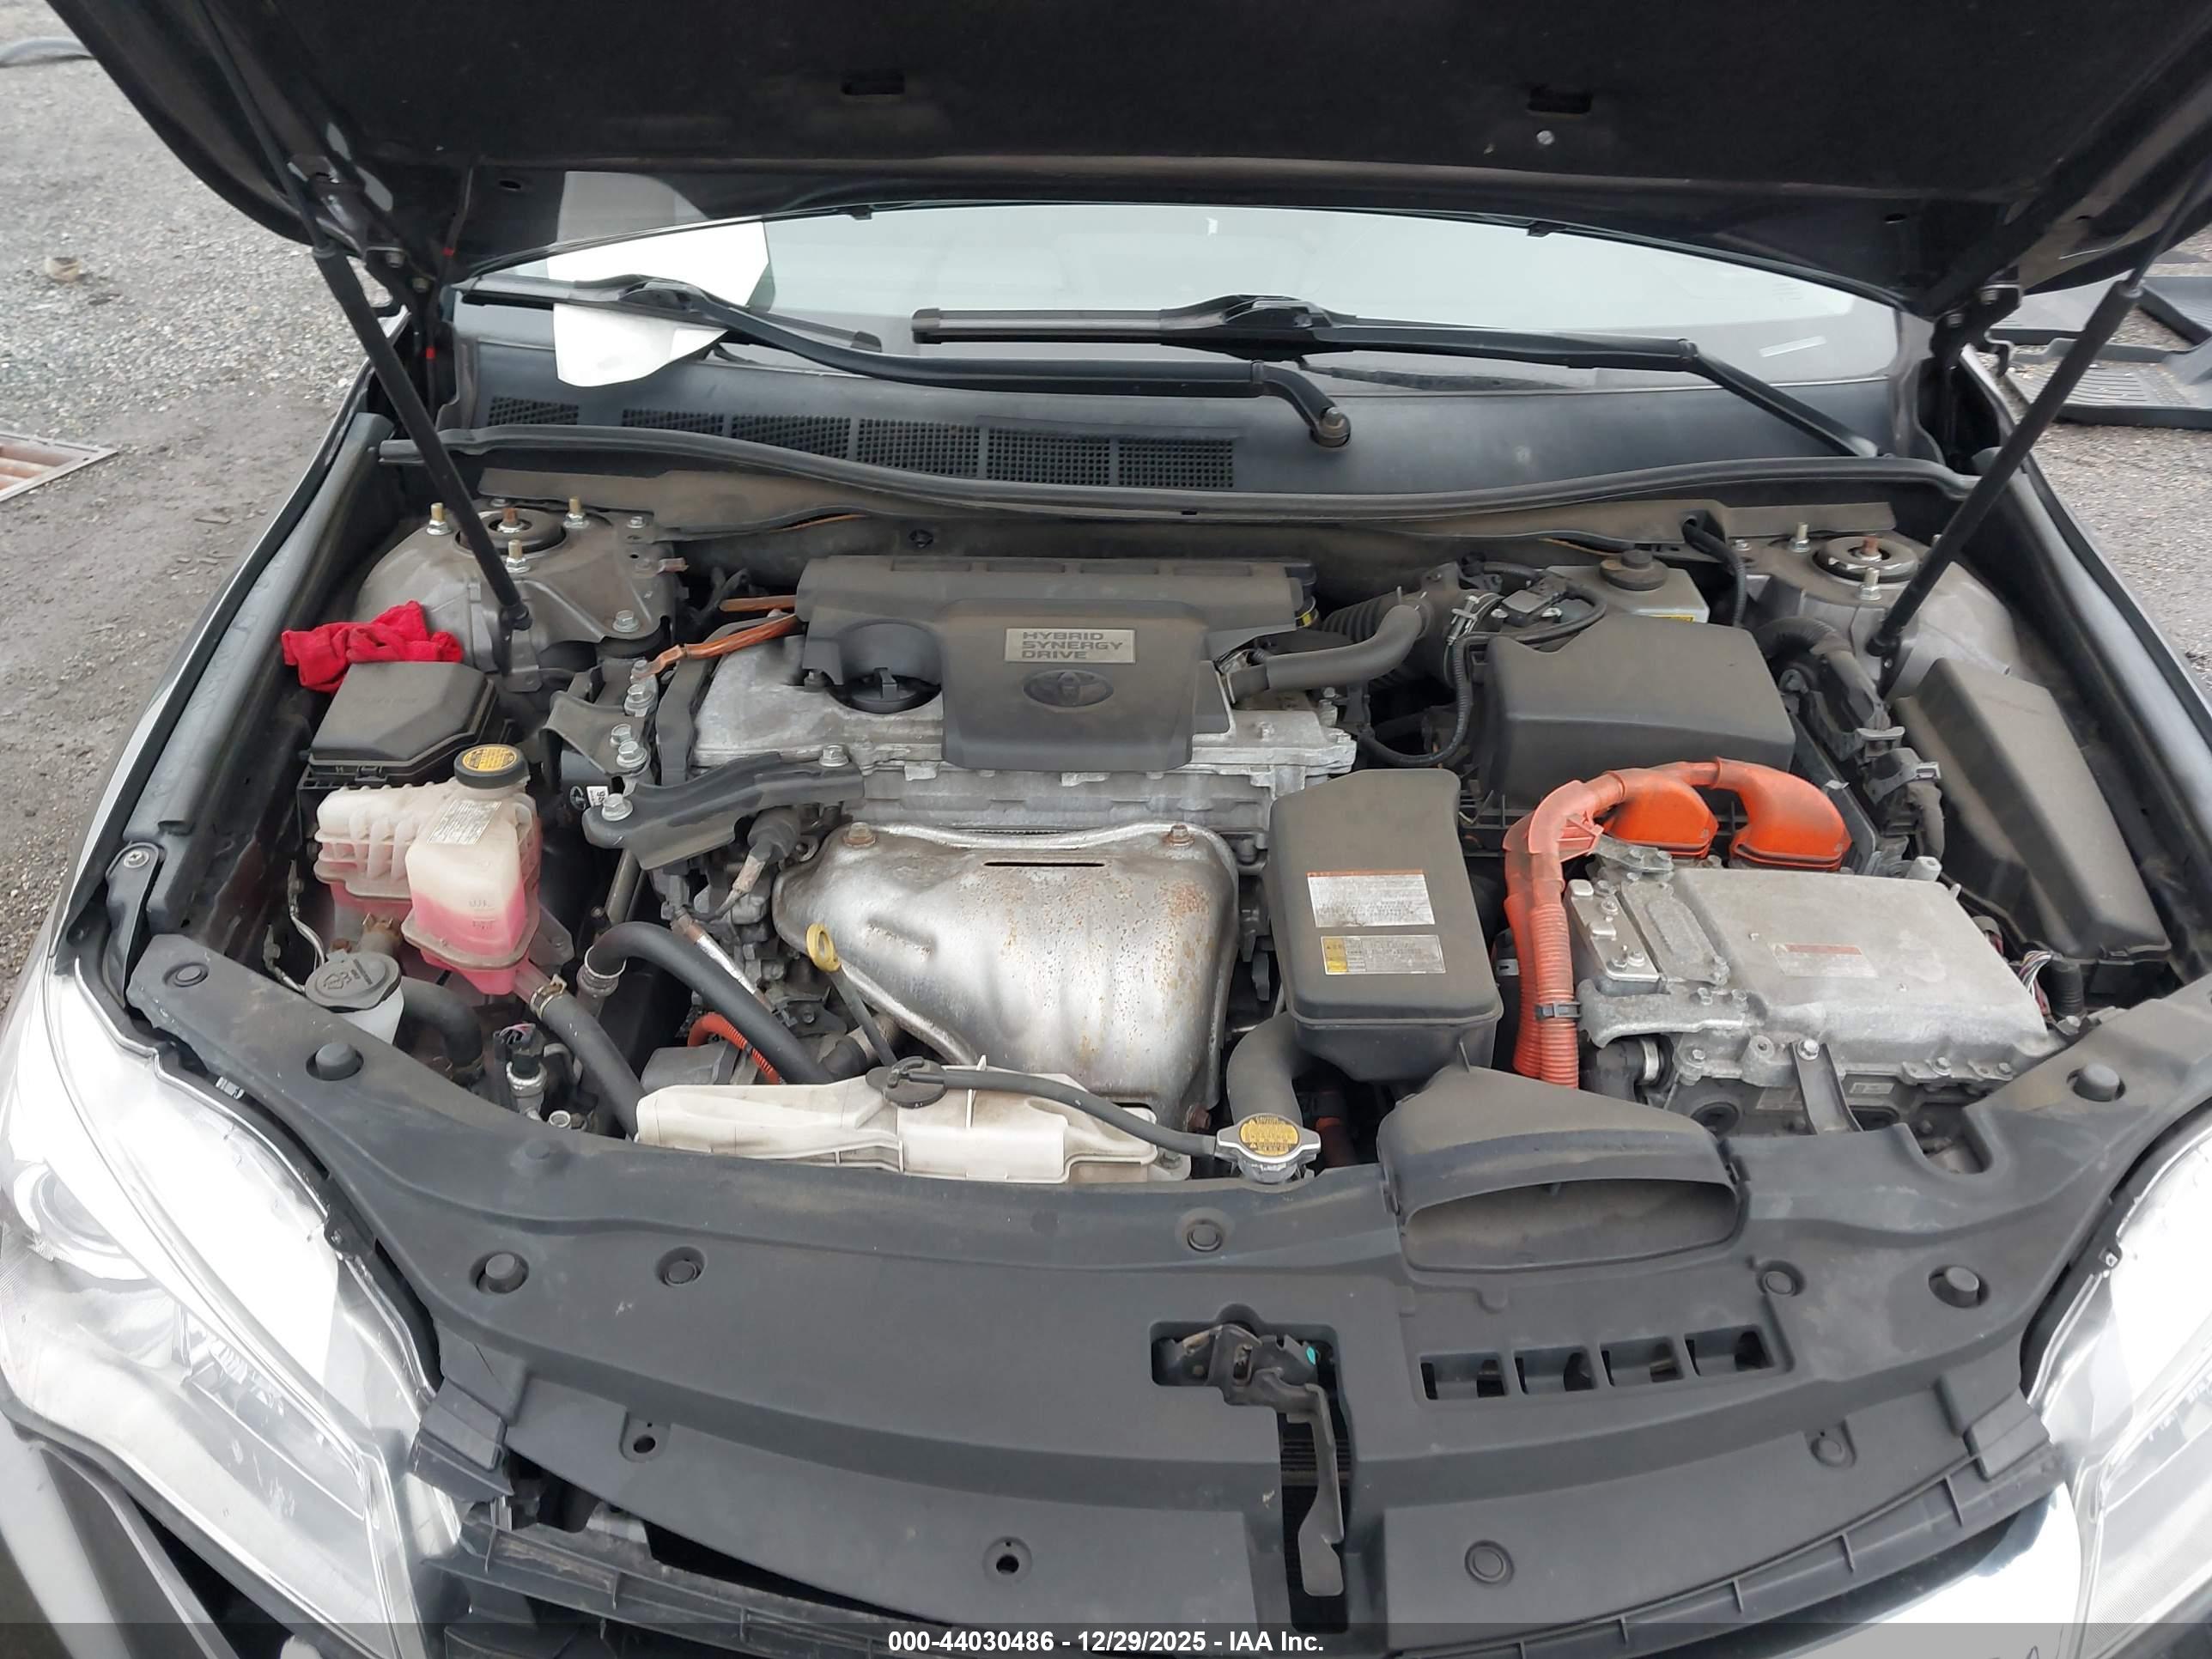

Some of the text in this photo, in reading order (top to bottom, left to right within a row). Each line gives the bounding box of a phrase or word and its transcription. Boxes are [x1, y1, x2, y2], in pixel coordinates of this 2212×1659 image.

[1022, 631, 1104, 641] HYBRID
[1021, 641, 1123, 650] SYNERGY
[1021, 650, 1087, 659] DRIVE
